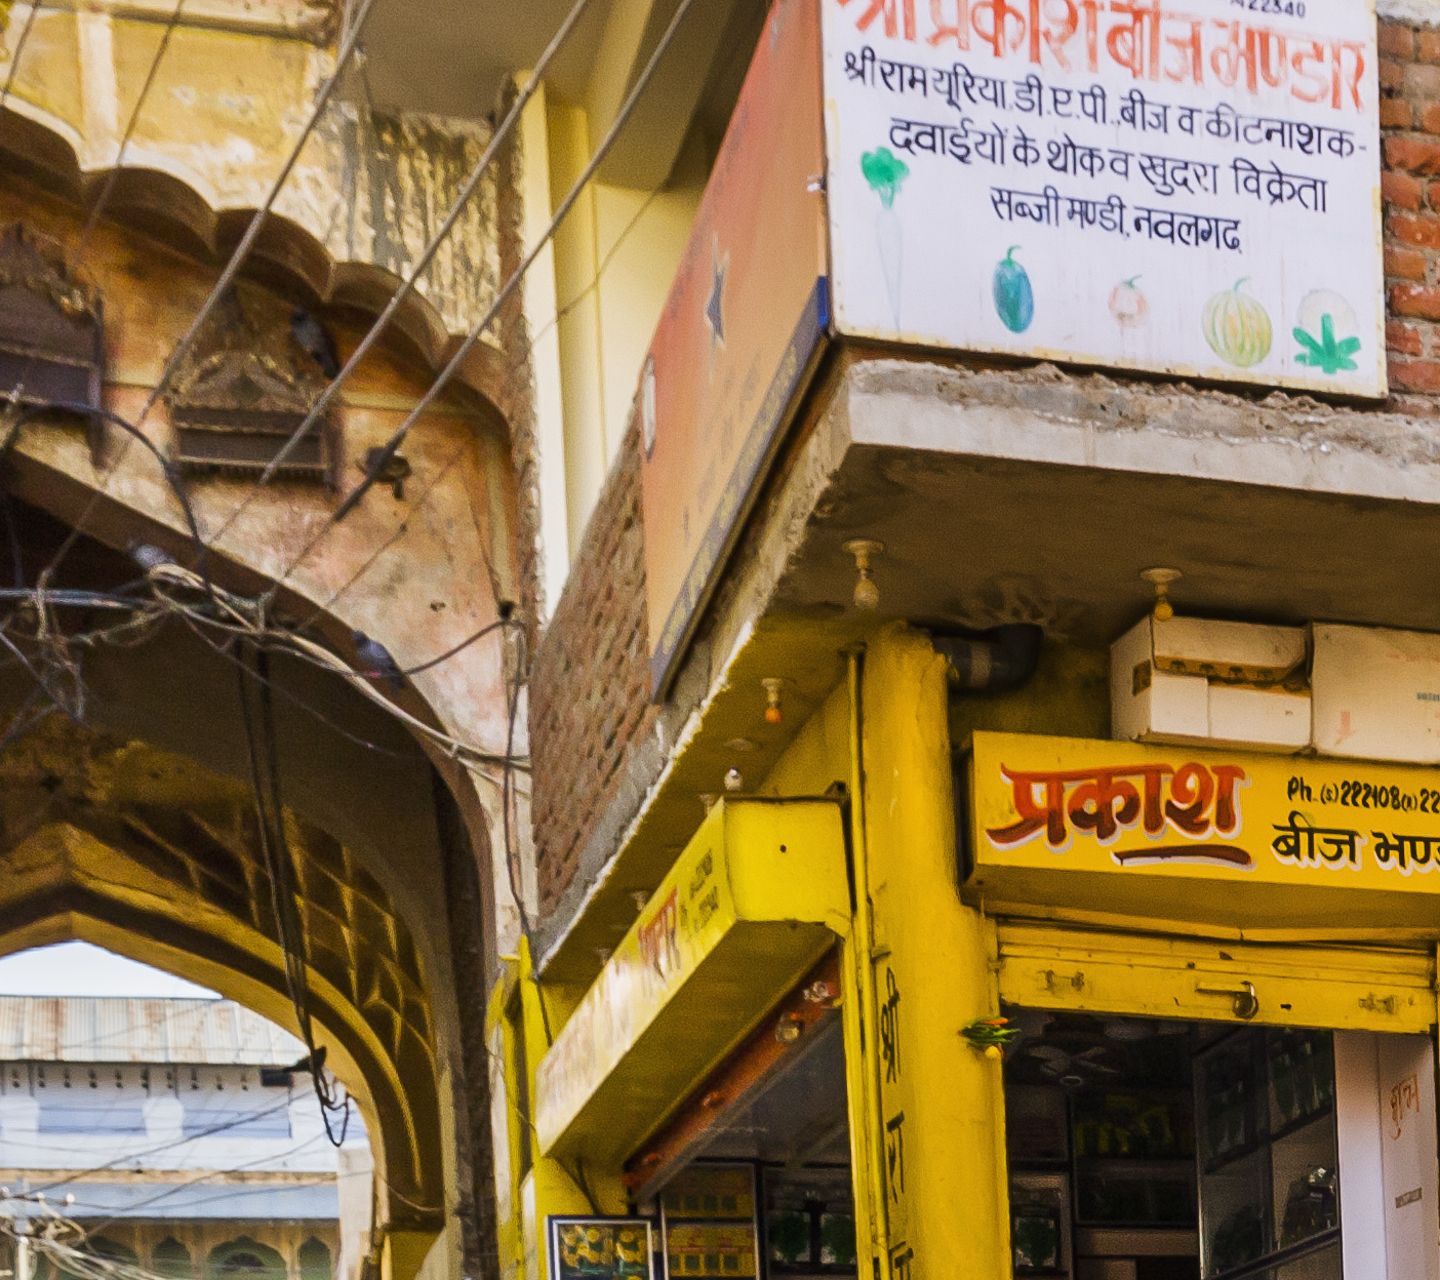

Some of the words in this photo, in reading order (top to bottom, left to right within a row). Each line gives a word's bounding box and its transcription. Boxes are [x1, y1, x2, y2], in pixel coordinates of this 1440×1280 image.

[1121, 90, 1170, 137] बीज
[1177, 106, 1202, 137] व
[1013, 127, 1042, 167] के
[986, 761, 1250, 850] प्रकाश
[1271, 808, 1364, 868] बीज
